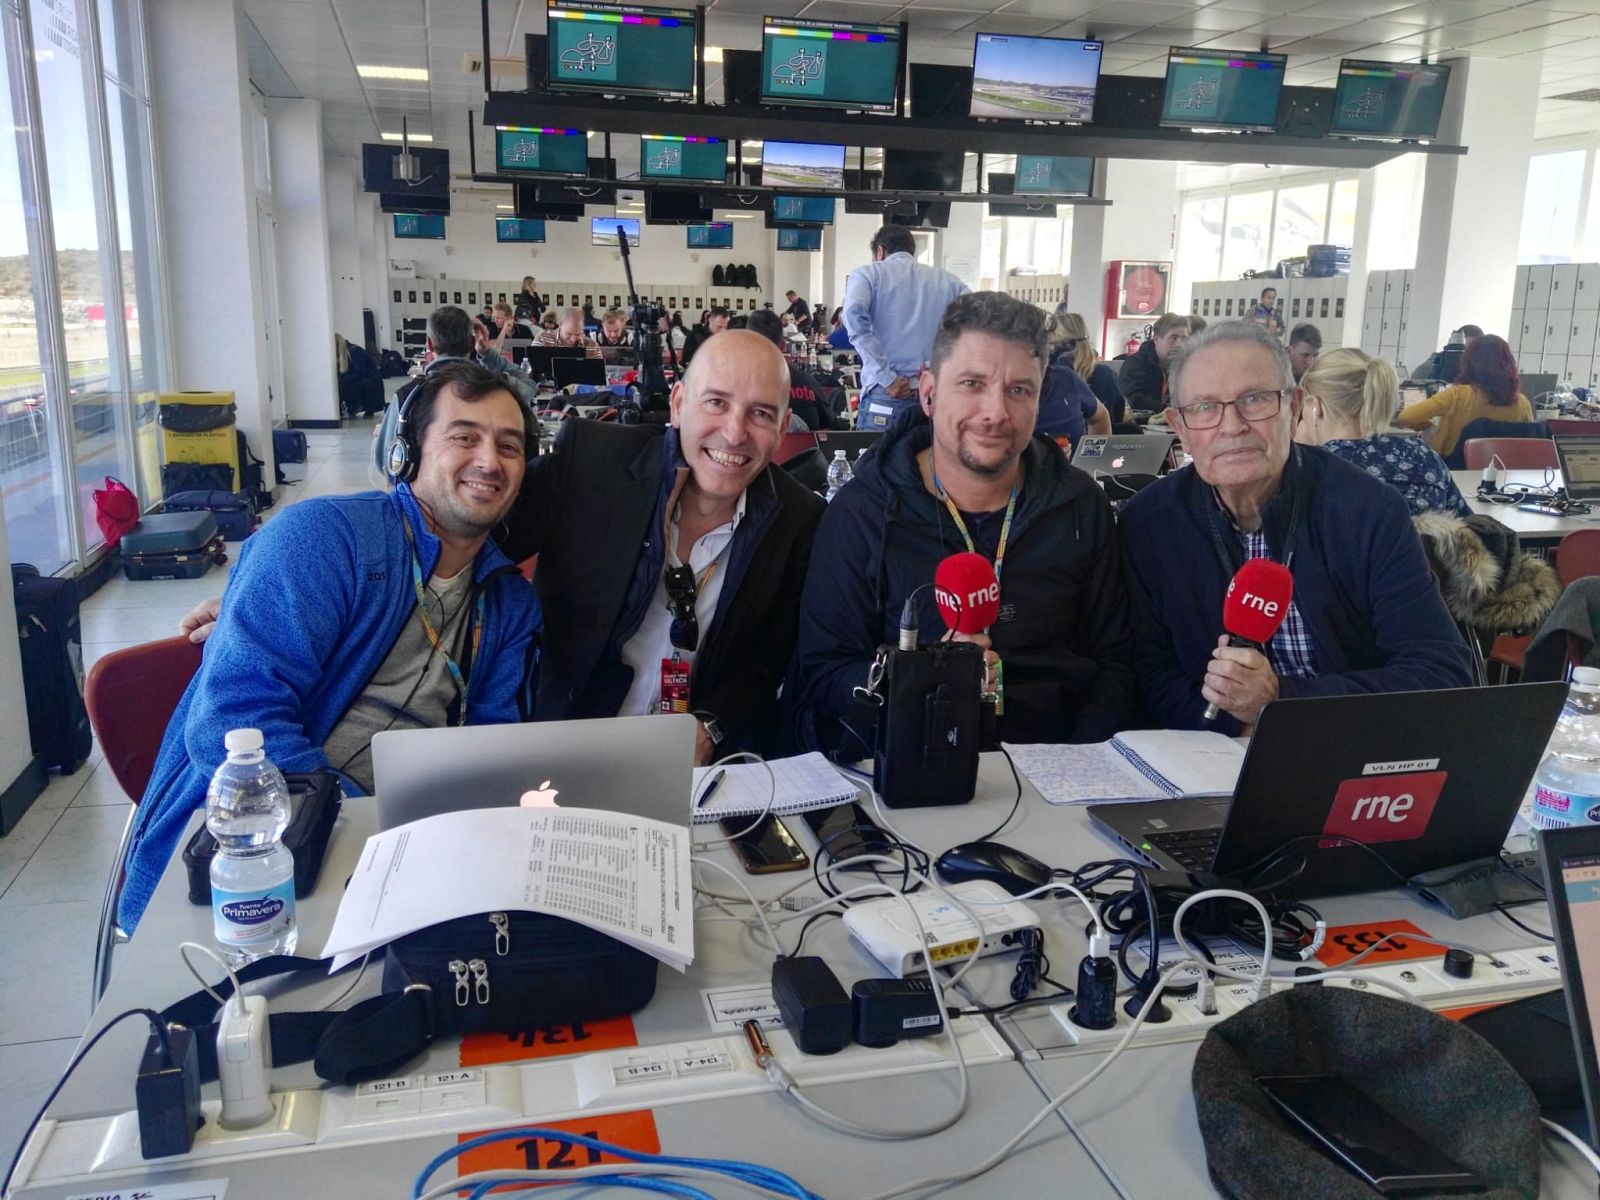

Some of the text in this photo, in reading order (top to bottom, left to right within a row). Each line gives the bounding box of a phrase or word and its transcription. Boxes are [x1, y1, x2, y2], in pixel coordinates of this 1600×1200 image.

[967, 582, 1000, 609] rne
[1241, 591, 1279, 618] rne
[1371, 764, 1396, 772] VLN
[1398, 762, 1415, 770] HP
[1350, 793, 1415, 823] rne
[223, 902, 281, 918] Primavera
[1333, 931, 1409, 955] 133
[373, 1072, 470, 1091] 121-B 121-A
[515, 1130, 603, 1171] 121
